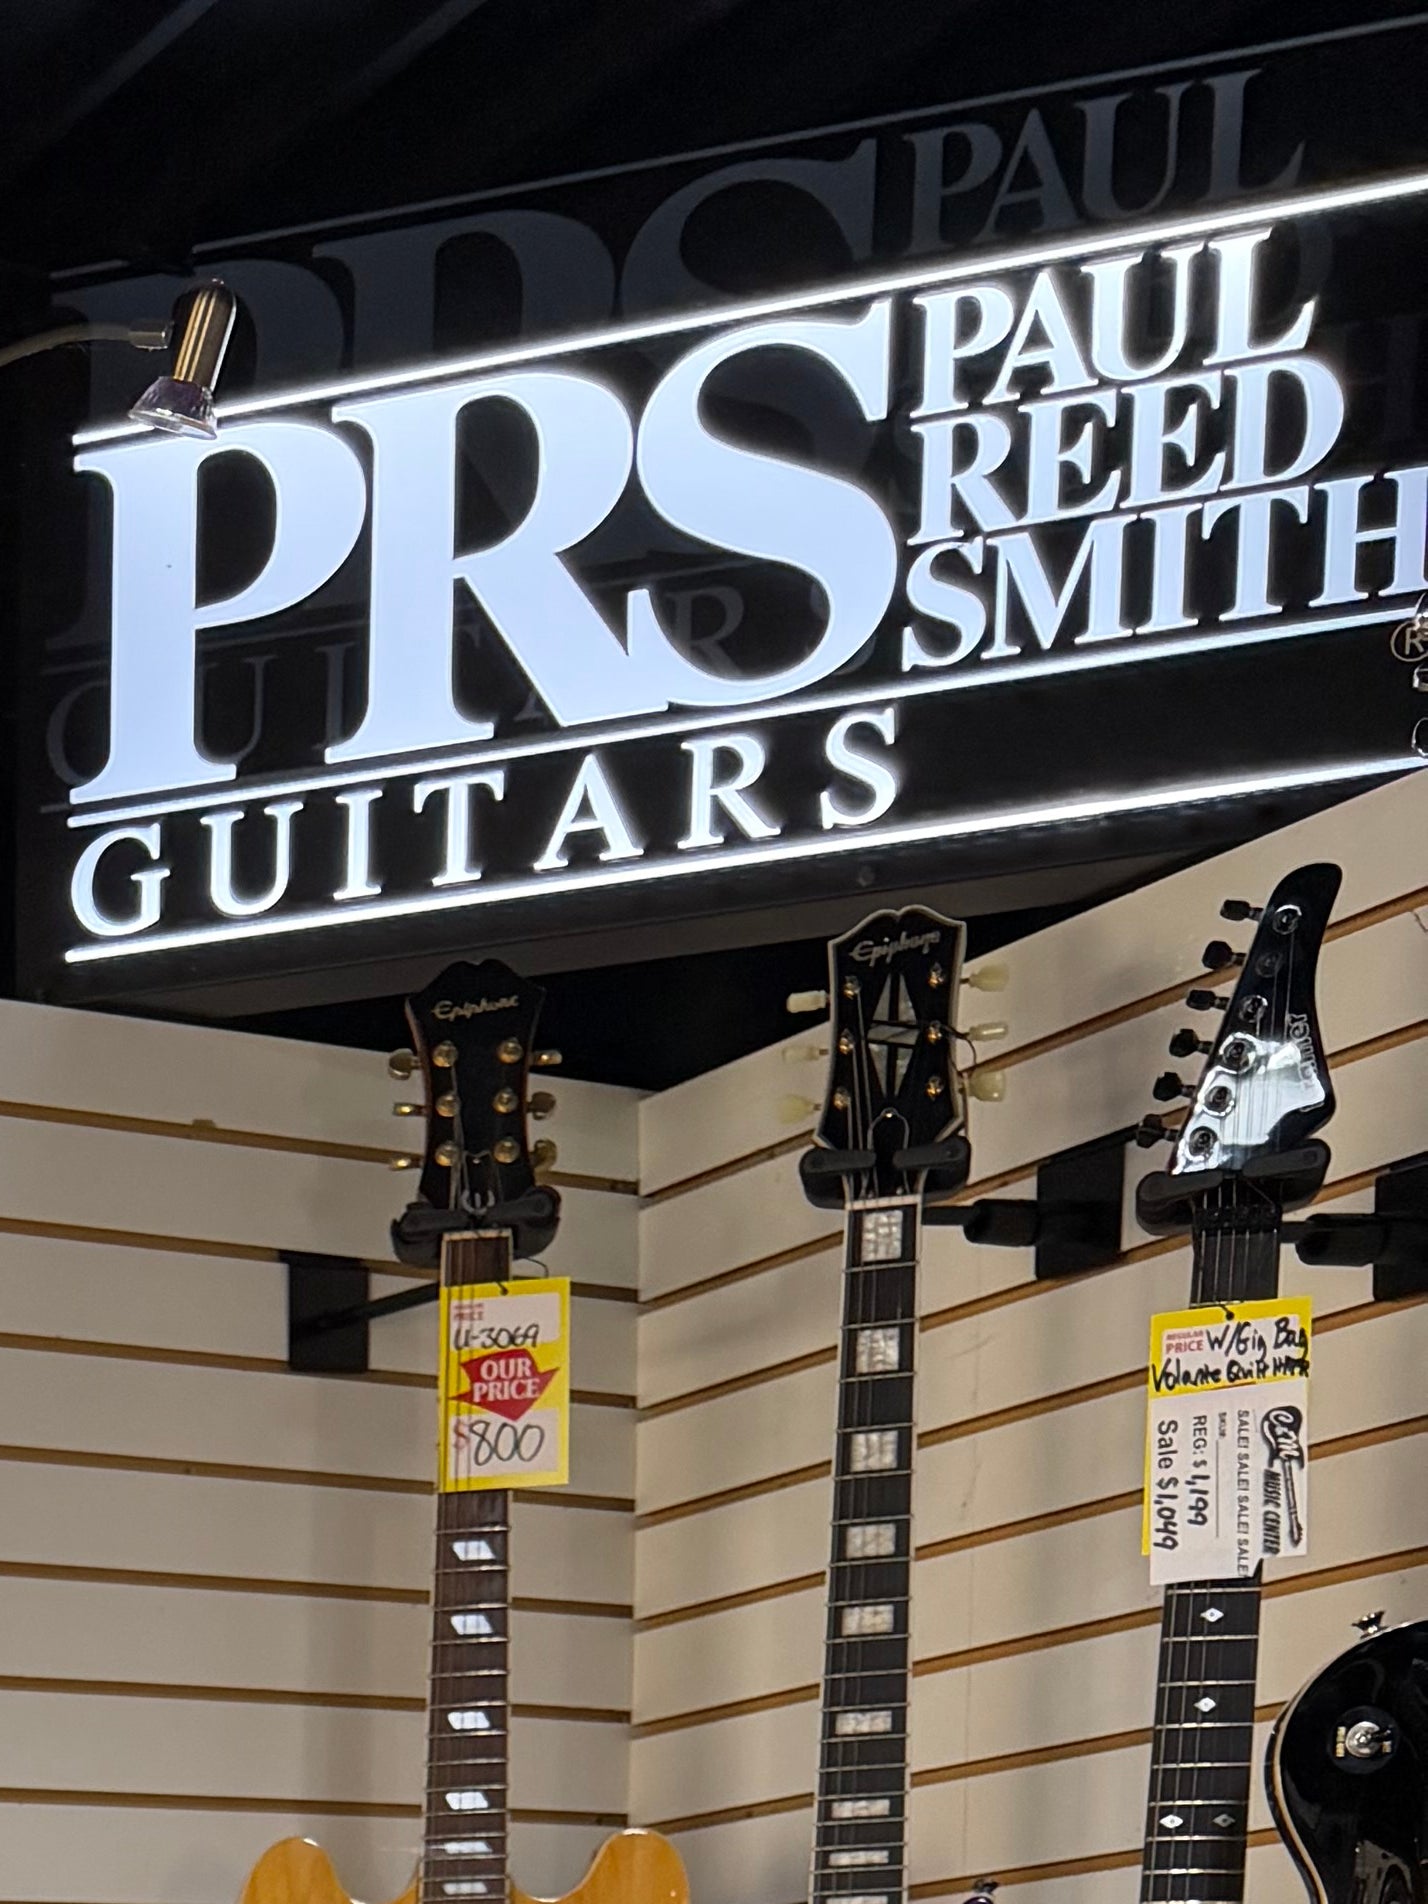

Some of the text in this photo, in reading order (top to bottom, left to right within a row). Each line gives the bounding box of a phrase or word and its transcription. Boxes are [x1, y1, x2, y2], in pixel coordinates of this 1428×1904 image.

[910, 226, 1317, 418] PAUL
[907, 355, 1344, 546] REED
[69, 301, 897, 804] PRS
[901, 466, 1428, 671] SMITH
[69, 707, 900, 937] GUITARS
[848, 931, 941, 967] Epiphone
[431, 995, 519, 1021] Epiphone
[480, 1357, 533, 1381] OUR
[1165, 1340, 1205, 1354] PRICE
[472, 1377, 541, 1403] PRICE
[1157, 1419, 1178, 1470] Sale
[1191, 1414, 1208, 1455] REG:
[1262, 1468, 1282, 1556] MUSIC CENTER
